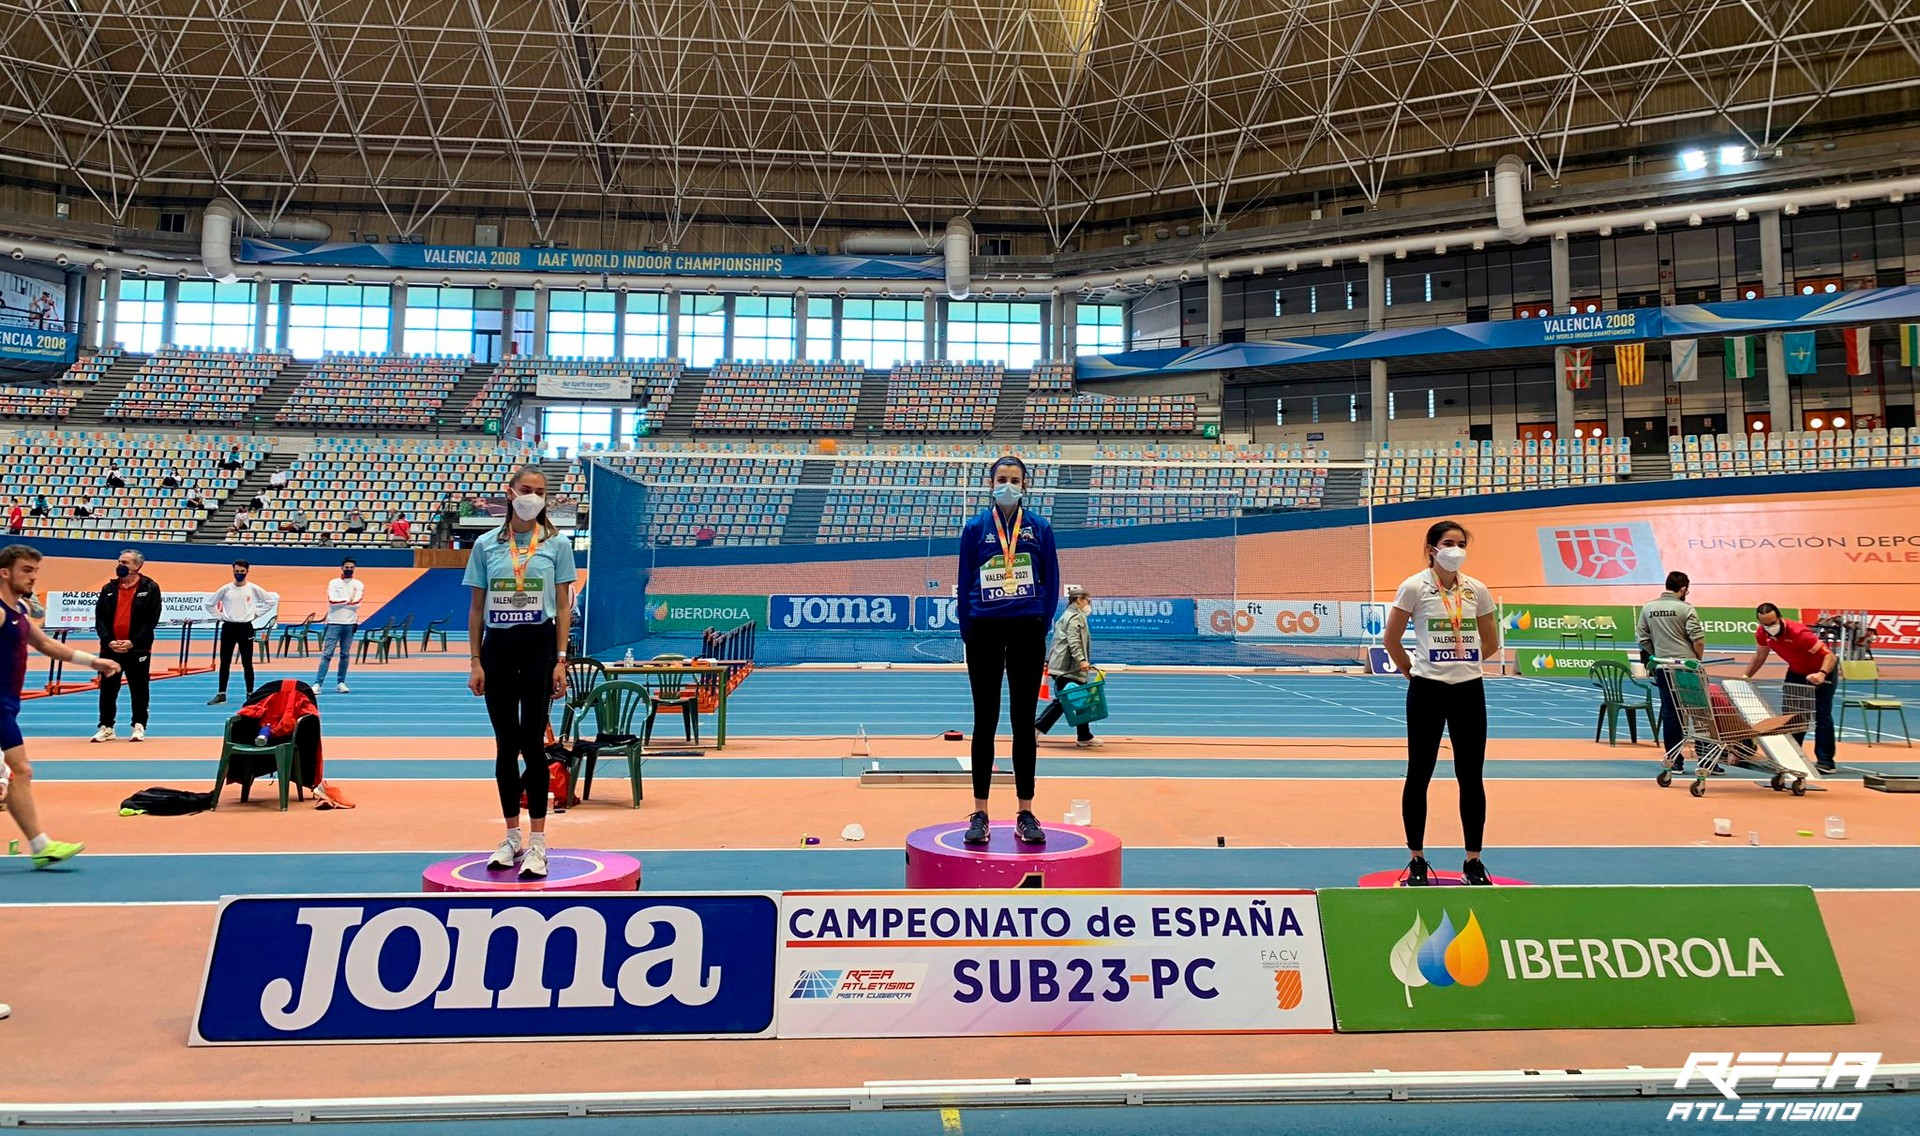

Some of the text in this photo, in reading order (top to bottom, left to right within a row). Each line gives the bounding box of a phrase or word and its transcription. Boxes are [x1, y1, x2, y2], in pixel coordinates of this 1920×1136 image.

[424, 248, 783, 273] VALENCIA 2008 IAAF WORLD INDOOR CHAMPIONSHIPS
[1543, 313, 1636, 334] VALENCIA 2008
[0, 331, 67, 350] NCIA 2008
[1687, 535, 1847, 549] FUNDACIÓN
[1844, 552, 1920, 563] VALE
[1015, 570, 1029, 580] 2021
[493, 596, 512, 605] VALEN
[670, 607, 750, 620] IBERDROLA
[1091, 600, 1173, 617] MONDO
[1210, 602, 1263, 633] GO fit
[1276, 603, 1328, 634] GO fit
[1462, 635, 1475, 644] 2021
[788, 899, 1304, 939] CAMPEONATO de ESPAÑA
[1260, 949, 1298, 961] FACV
[1500, 937, 1784, 980] IBERDROLA
[845, 969, 895, 982] RFEA
[953, 957, 1220, 1004] SUB23-PC
[840, 982, 916, 991] ATLETISMO
[836, 992, 913, 1000] PISTA CUBIERTA
